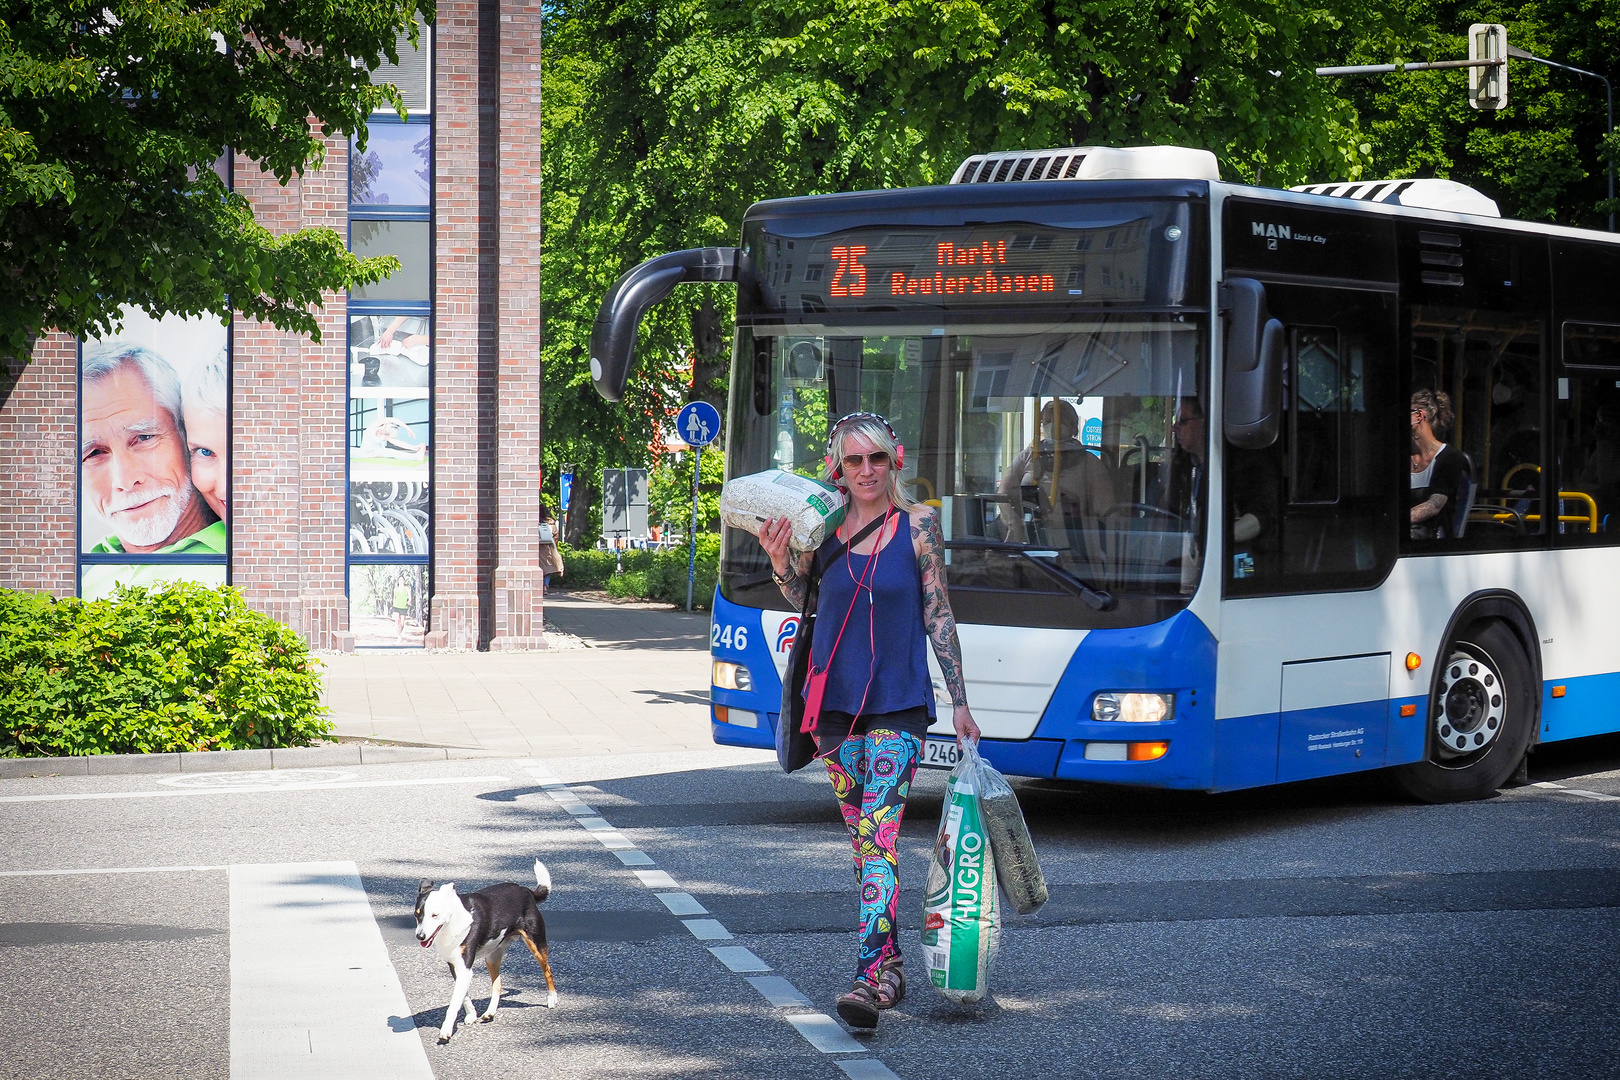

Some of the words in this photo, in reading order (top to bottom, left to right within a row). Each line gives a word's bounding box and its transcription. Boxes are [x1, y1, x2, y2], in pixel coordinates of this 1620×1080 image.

[1252, 222, 1291, 240] MAN
[1294, 233, 1312, 242] Lion's
[1312, 235, 1326, 244] City
[937, 240, 1007, 266] Markt
[831, 245, 867, 297] 25
[891, 270, 1055, 296] Reutershagen
[712, 623, 748, 651] 246
[929, 743, 957, 764] 246
[954, 832, 982, 926] HUGRO
